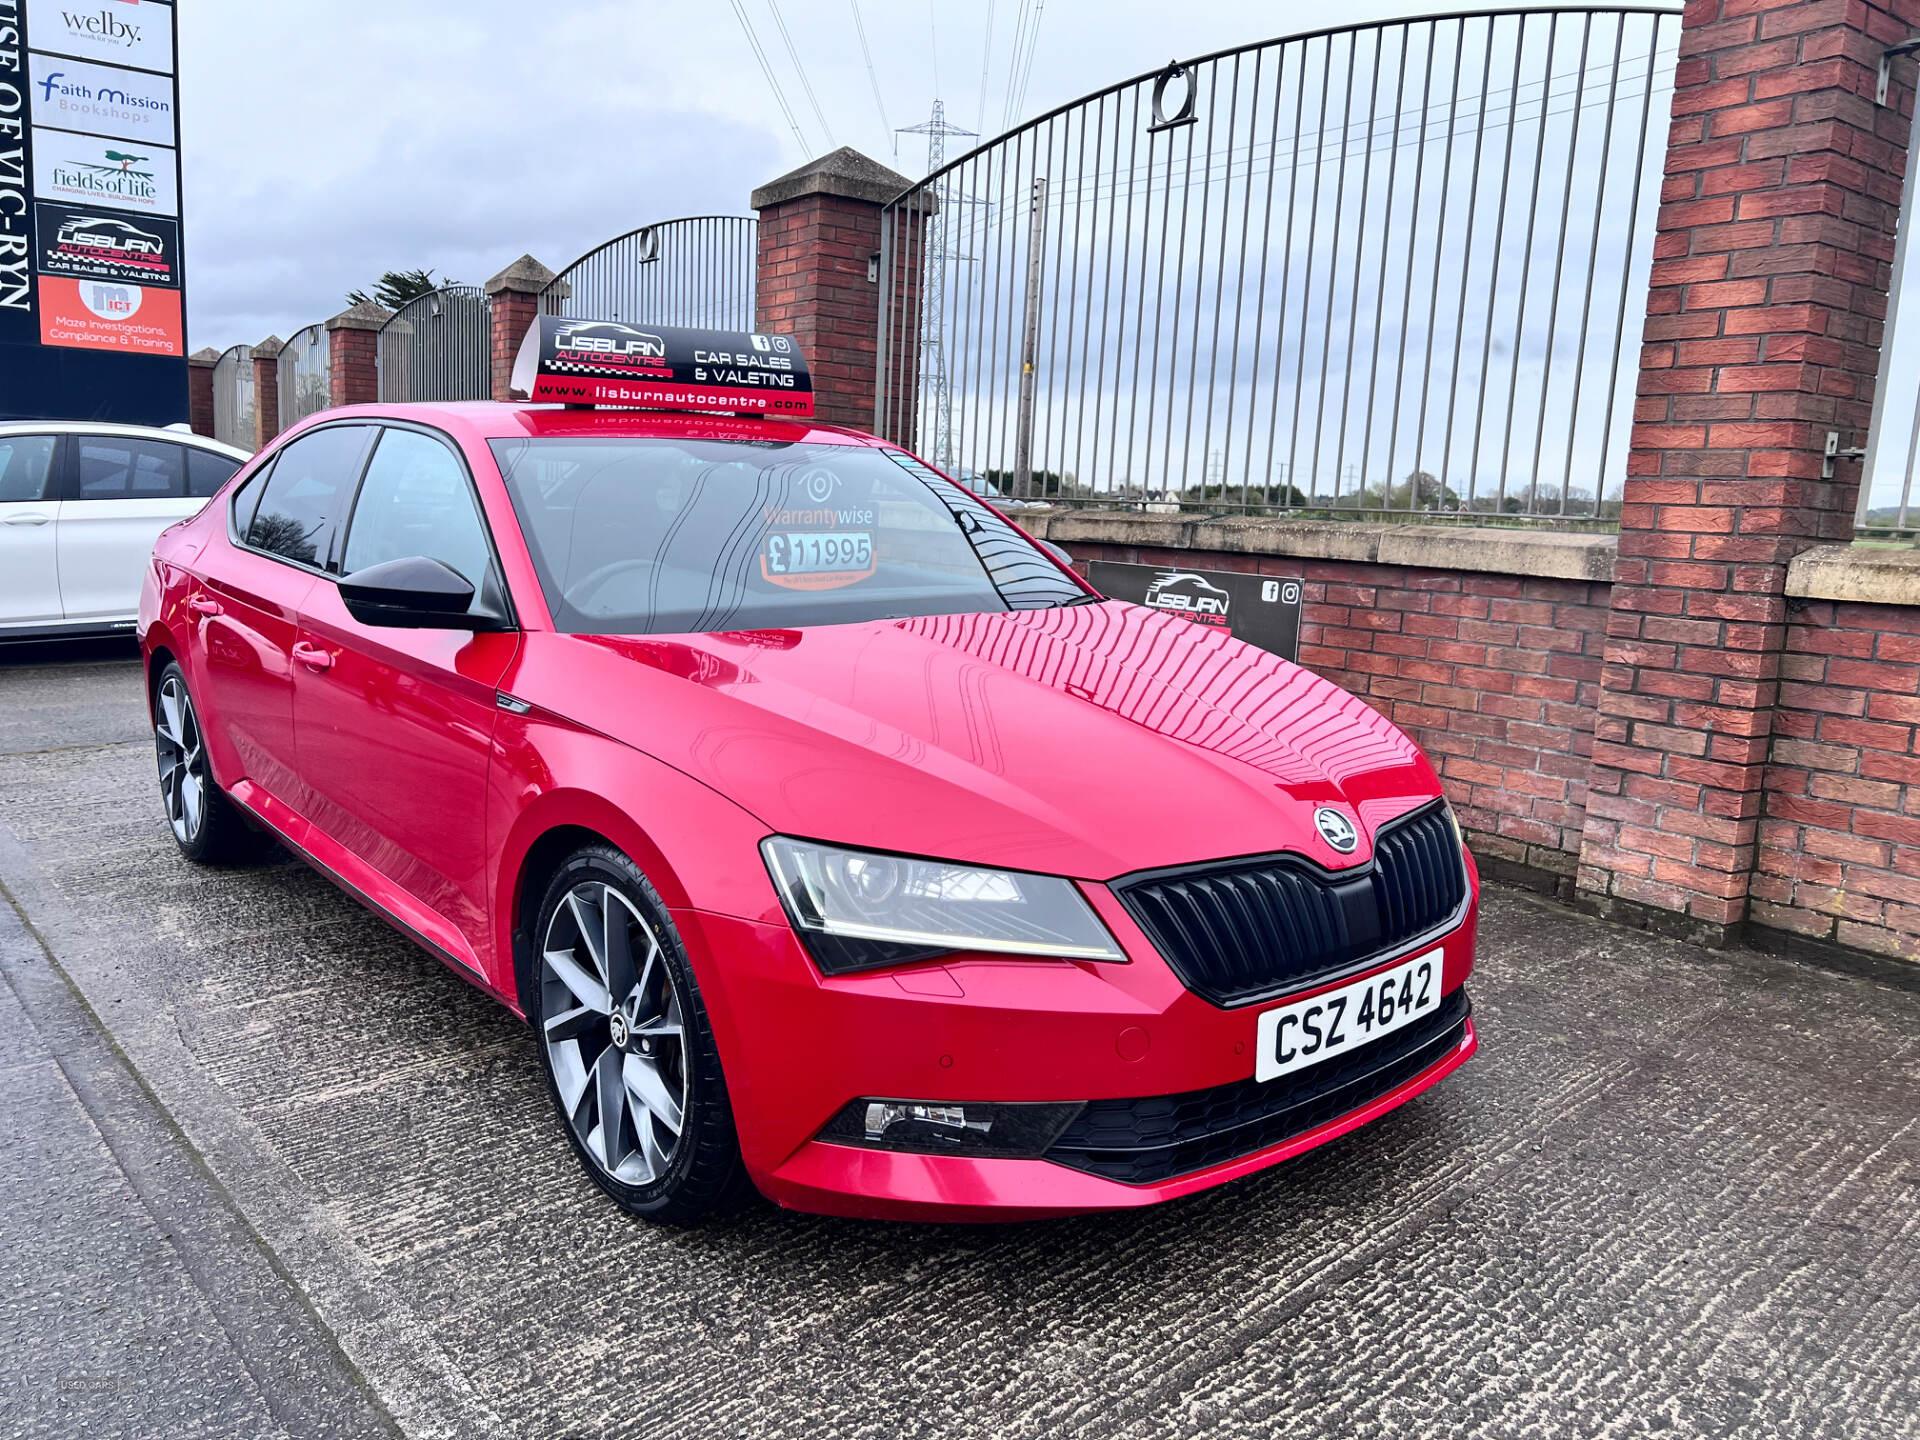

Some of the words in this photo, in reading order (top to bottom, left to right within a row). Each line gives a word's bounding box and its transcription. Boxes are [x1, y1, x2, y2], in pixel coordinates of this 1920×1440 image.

[61, 10, 142, 47] welby.
[0, 82, 23, 140] OF
[59, 100, 150, 124] Bookshops
[52, 185, 86, 195] CHANGING
[108, 193, 137, 203] BUILDING
[53, 168, 103, 191] fields
[106, 177, 126, 194] of
[128, 179, 156, 199] life
[0, 146, 31, 312] VIC-RYN
[57, 229, 163, 255] LISBURN
[57, 242, 163, 263] AUTOCENTRE
[47, 260, 70, 271] CAR
[72, 263, 108, 274] SALES
[110, 267, 118, 275] &
[120, 268, 171, 282] VALETING
[109, 300, 132, 312] ICT
[55, 316, 86, 328] Maze
[49, 328, 117, 345] Compliance
[120, 335, 128, 345] &
[131, 335, 174, 352] Training
[554, 334, 665, 357] LISBURN
[555, 350, 666, 366] AUTOCENTRE
[694, 350, 732, 365] CAR
[736, 354, 792, 370] SALES
[695, 368, 707, 381] &
[713, 368, 795, 387] VALETING
[539, 384, 808, 410] www.lisburnautocentre.com
[763, 505, 873, 529] Warrantywise
[769, 535, 870, 572] £11995
[1144, 591, 1230, 615] LISBURN
[1275, 995, 1348, 1064] CSZ
[1357, 962, 1432, 1033] 4642
